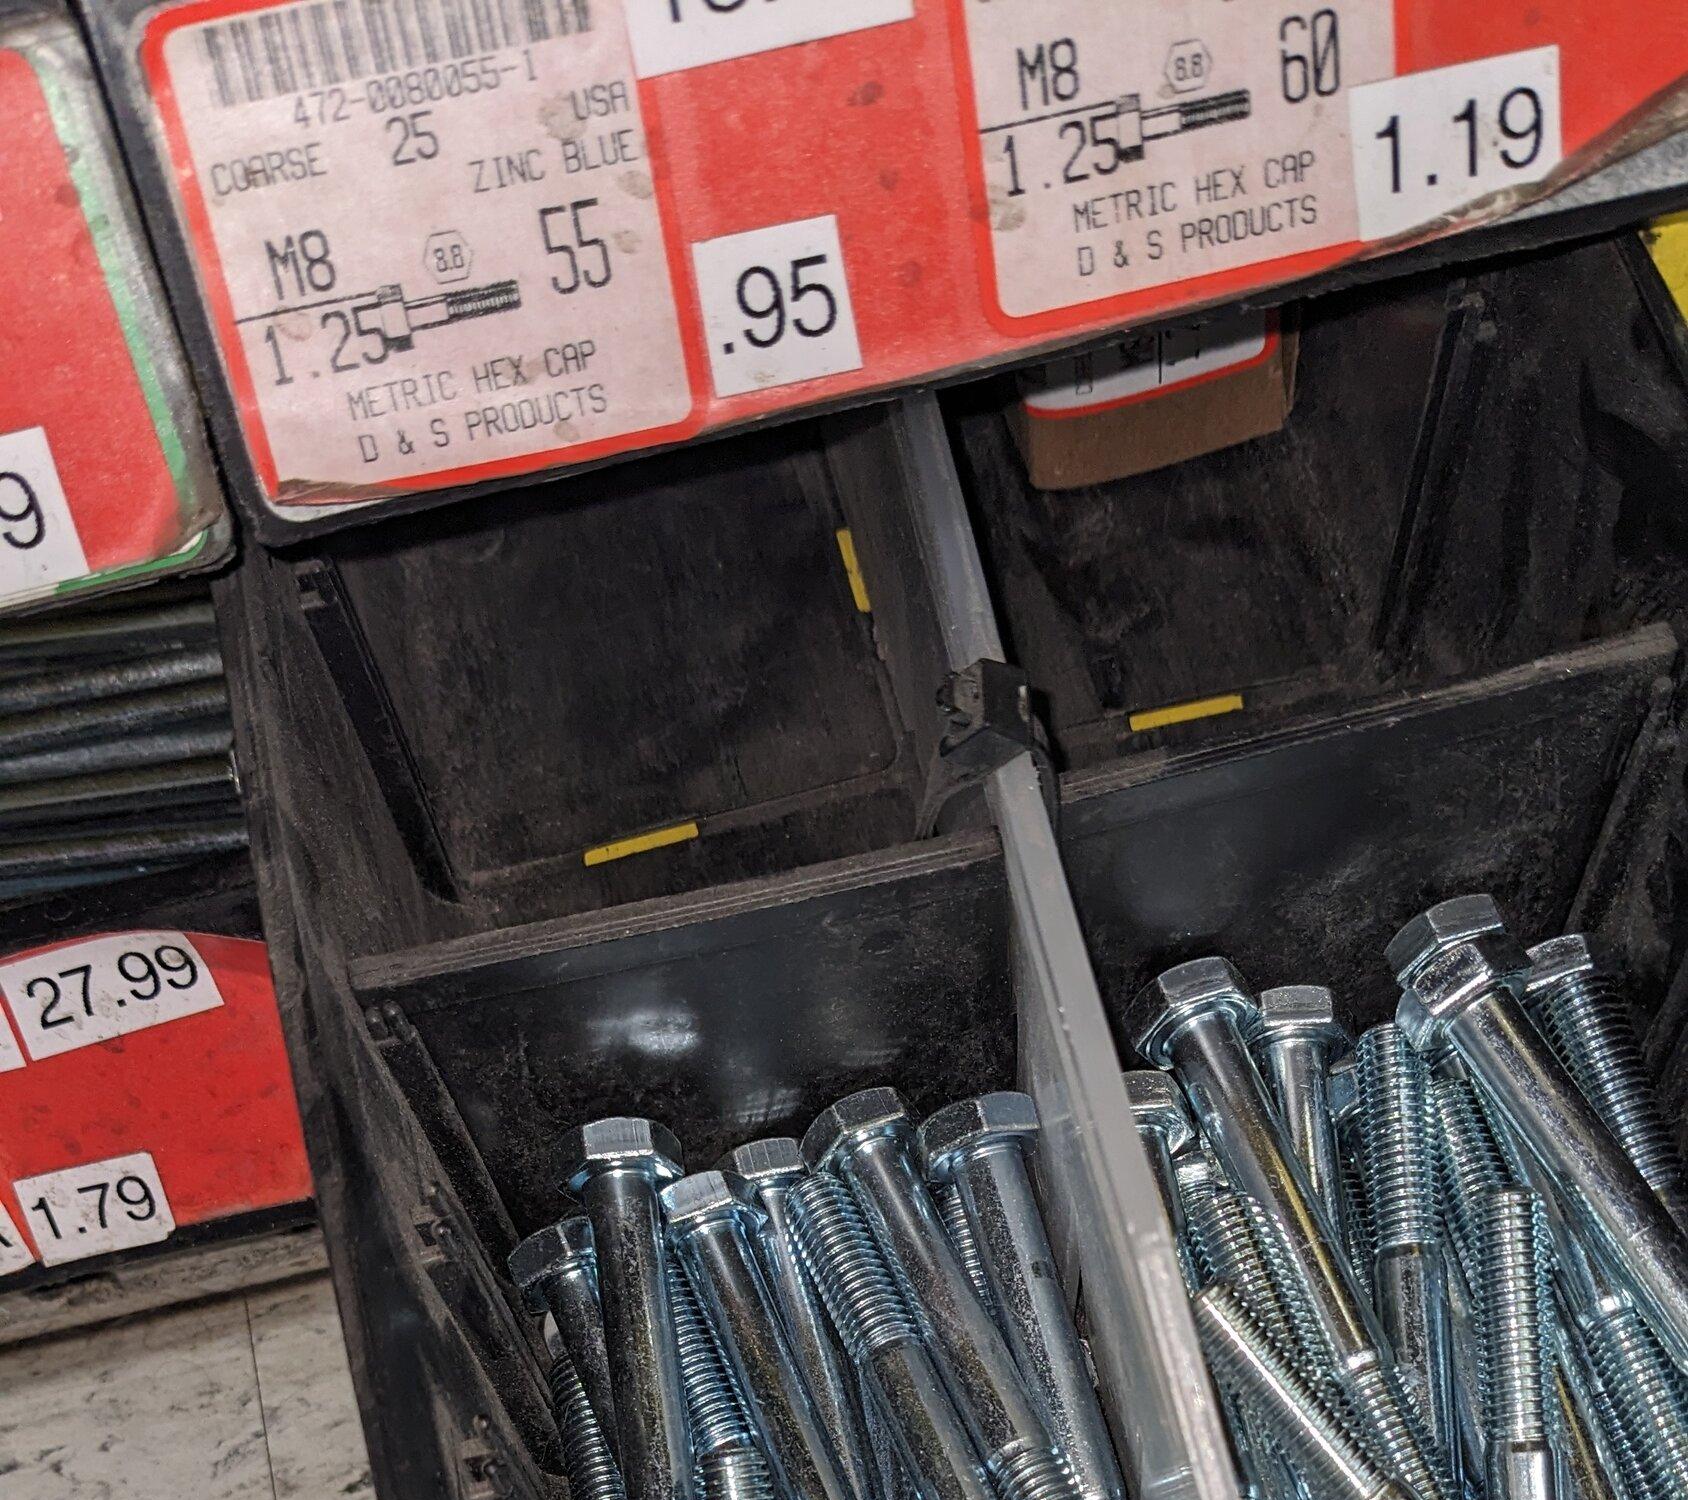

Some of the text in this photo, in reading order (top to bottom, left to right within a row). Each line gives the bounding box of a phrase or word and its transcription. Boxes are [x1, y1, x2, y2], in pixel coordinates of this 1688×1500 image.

[294, 49, 537, 128] 472-0080055-1
[1017, 37, 1079, 110] M8
[1280, 9, 1340, 103] 60
[385, 110, 439, 166] 25
[570, 80, 630, 121] USA
[1375, 86, 1543, 193] 1.19
[210, 142, 327, 196] COARSE
[468, 128, 639, 193] ZINC BLUE
[1004, 114, 1119, 196] 1.25
[1073, 151, 1315, 233] METRIC HEX CAP
[264, 229, 336, 300] M8
[539, 198, 612, 294] 55
[1078, 195, 1317, 276] D & S PRODUCTS
[721, 254, 838, 355] .95
[264, 307, 390, 386] 1.25
[347, 339, 596, 421] METRIC HEX CAP
[358, 383, 607, 463] D & S PRODUCTS
[27, 945, 198, 1029] 27.99
[32, 1176, 156, 1239] 1.79
